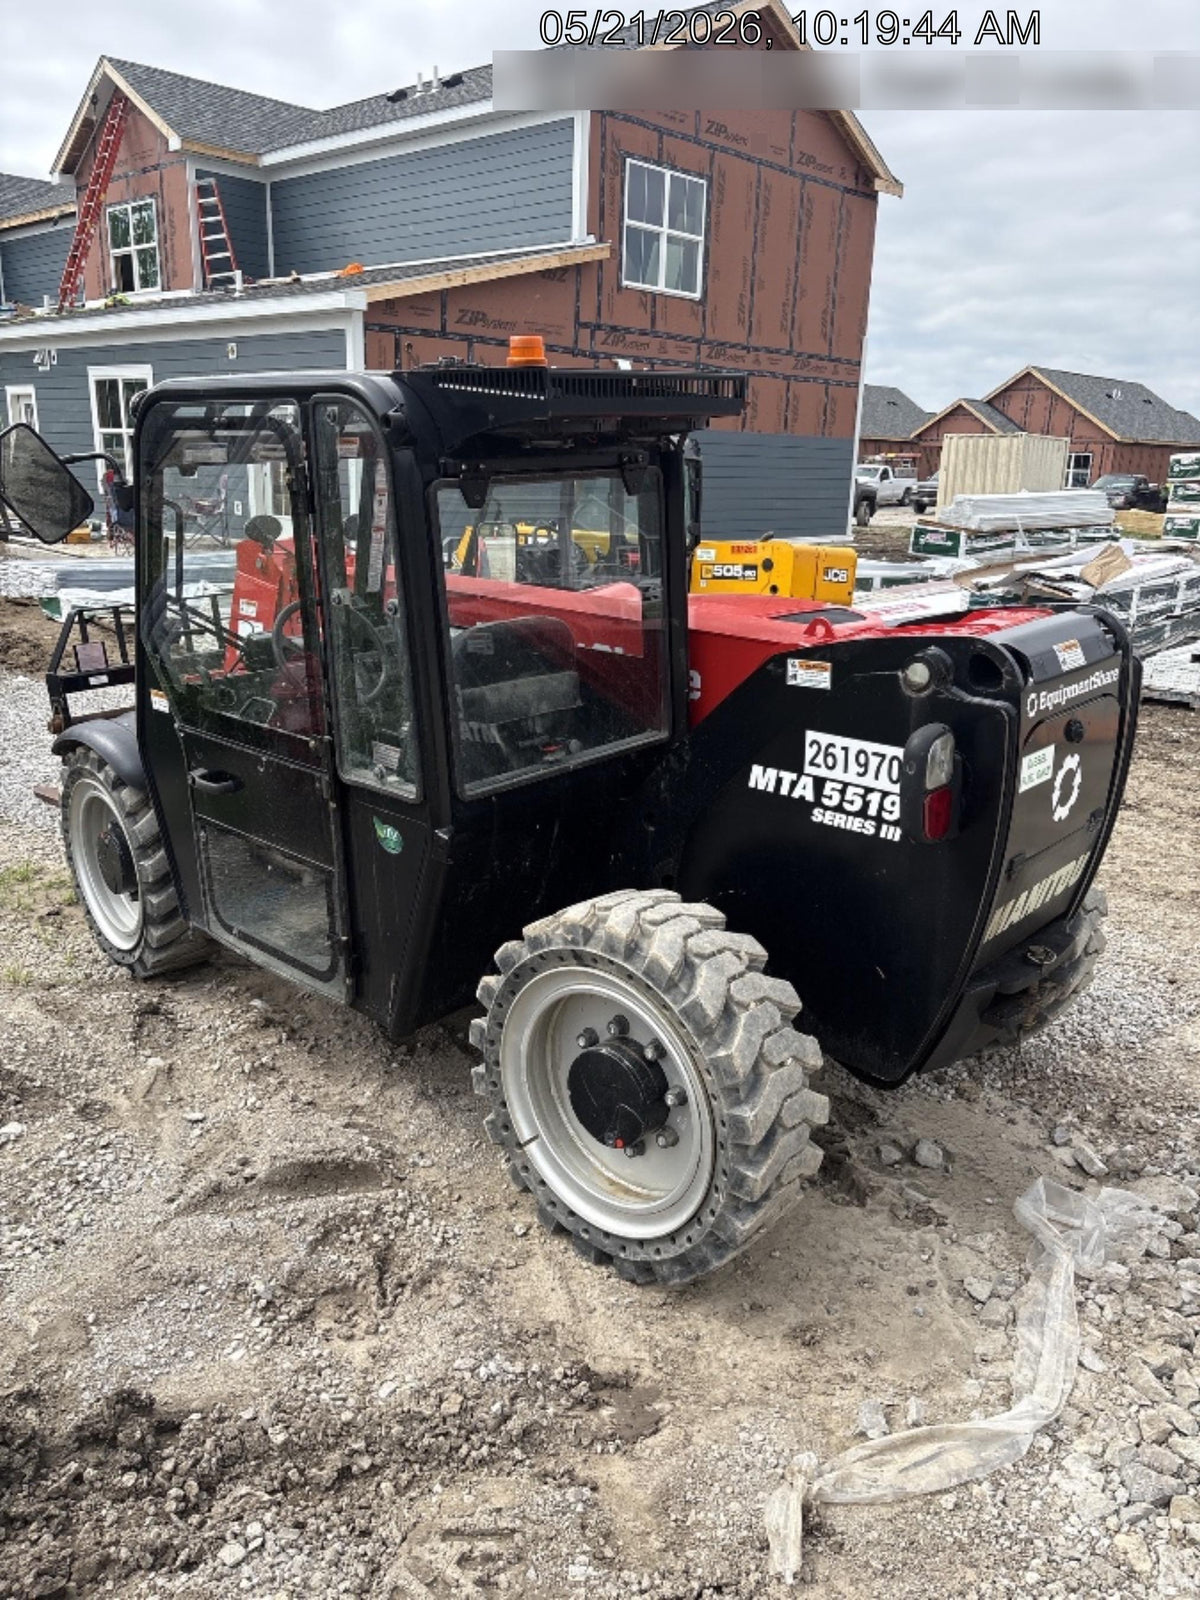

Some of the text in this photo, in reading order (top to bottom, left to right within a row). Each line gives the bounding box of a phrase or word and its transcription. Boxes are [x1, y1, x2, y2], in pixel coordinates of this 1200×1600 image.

[824, 568, 848, 582] JCB
[1039, 667, 1120, 711] EquipmentShare
[807, 738, 901, 785] 261970
[748, 763, 901, 822] MTA 5519
[810, 807, 902, 842] SERIES III
